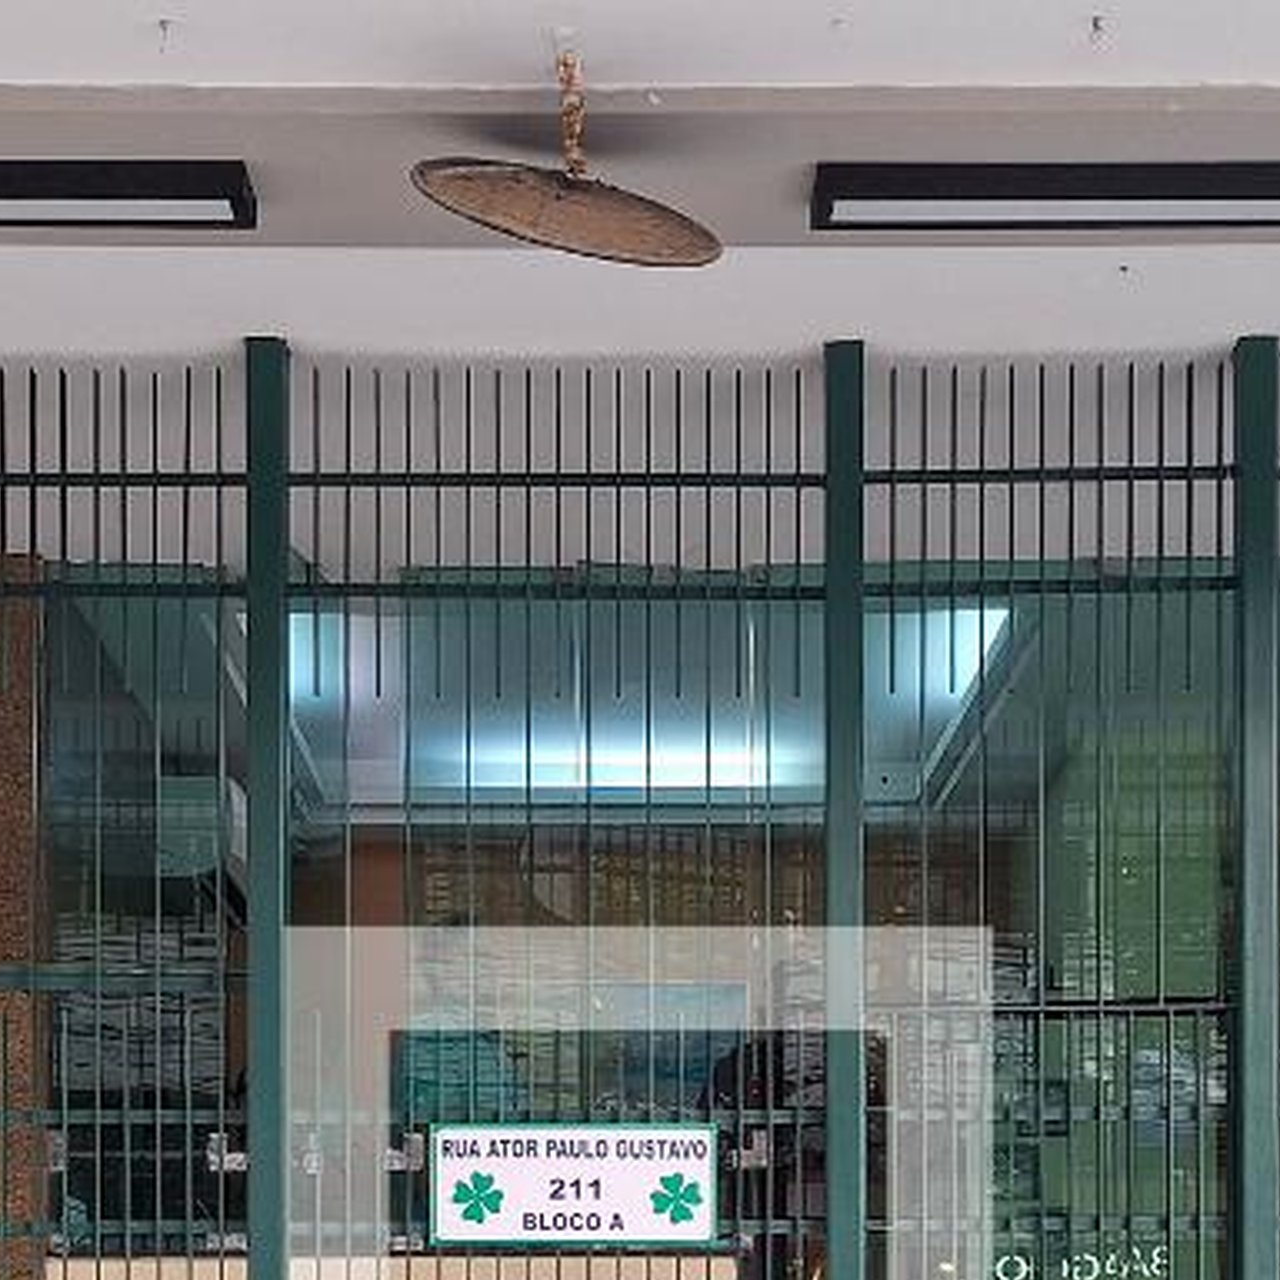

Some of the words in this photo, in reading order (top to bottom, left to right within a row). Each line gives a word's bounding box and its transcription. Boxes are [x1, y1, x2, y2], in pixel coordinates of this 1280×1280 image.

[442, 1140, 481, 1158] RUA
[486, 1140, 538, 1158] ATOR
[546, 1140, 607, 1158] PAULO
[615, 1139, 707, 1159] GUSTAVO
[549, 1178, 602, 1200] 211
[522, 1212, 601, 1231] BLOCO
[609, 1213, 624, 1230] A
